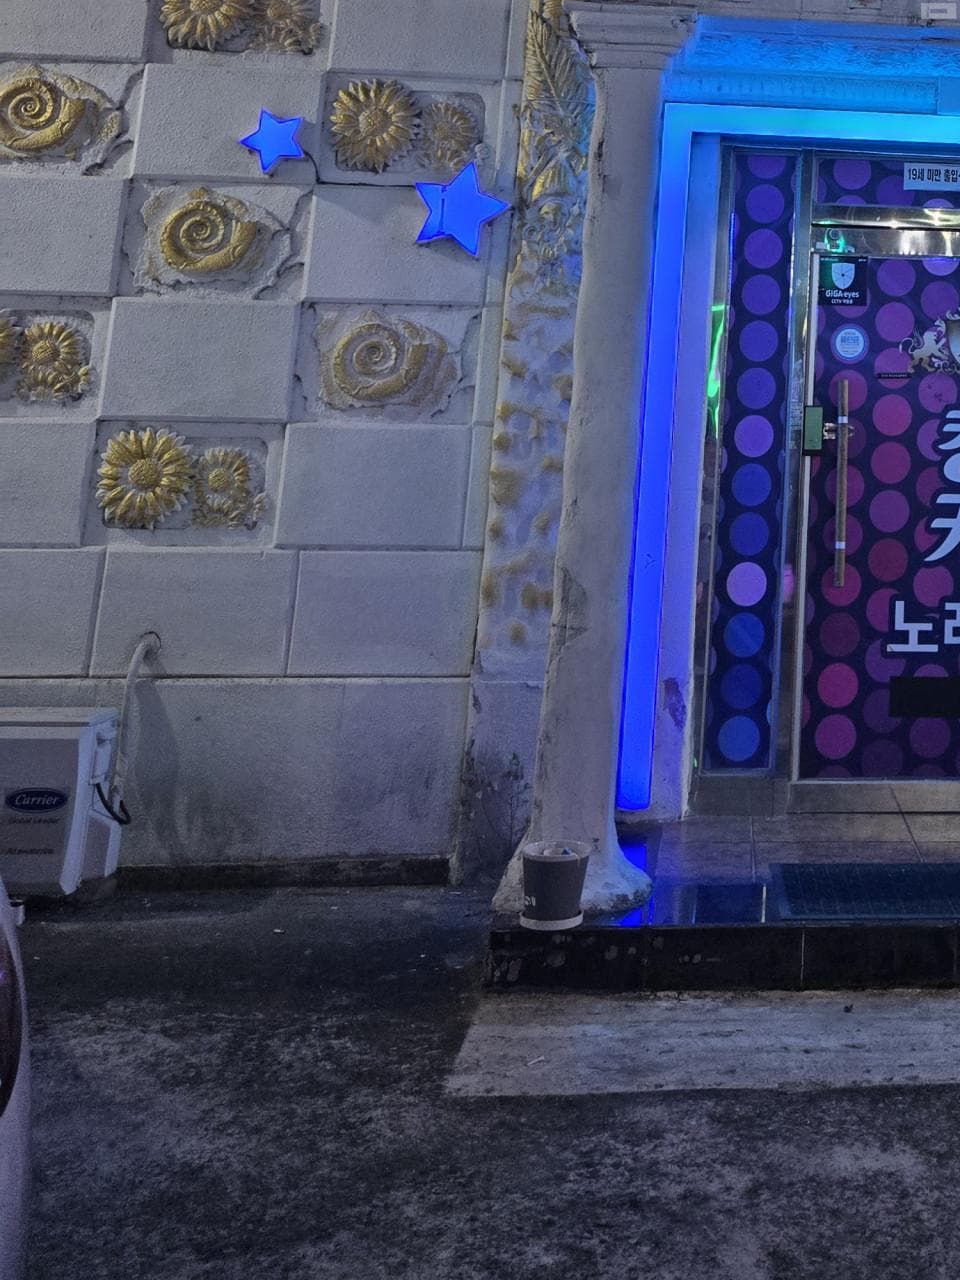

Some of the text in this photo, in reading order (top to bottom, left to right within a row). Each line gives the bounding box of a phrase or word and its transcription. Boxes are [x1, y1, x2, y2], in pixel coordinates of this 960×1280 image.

[908, 168, 925, 182] 19세
[927, 169, 942, 183] 미만
[15, 794, 60, 806] Carrier
